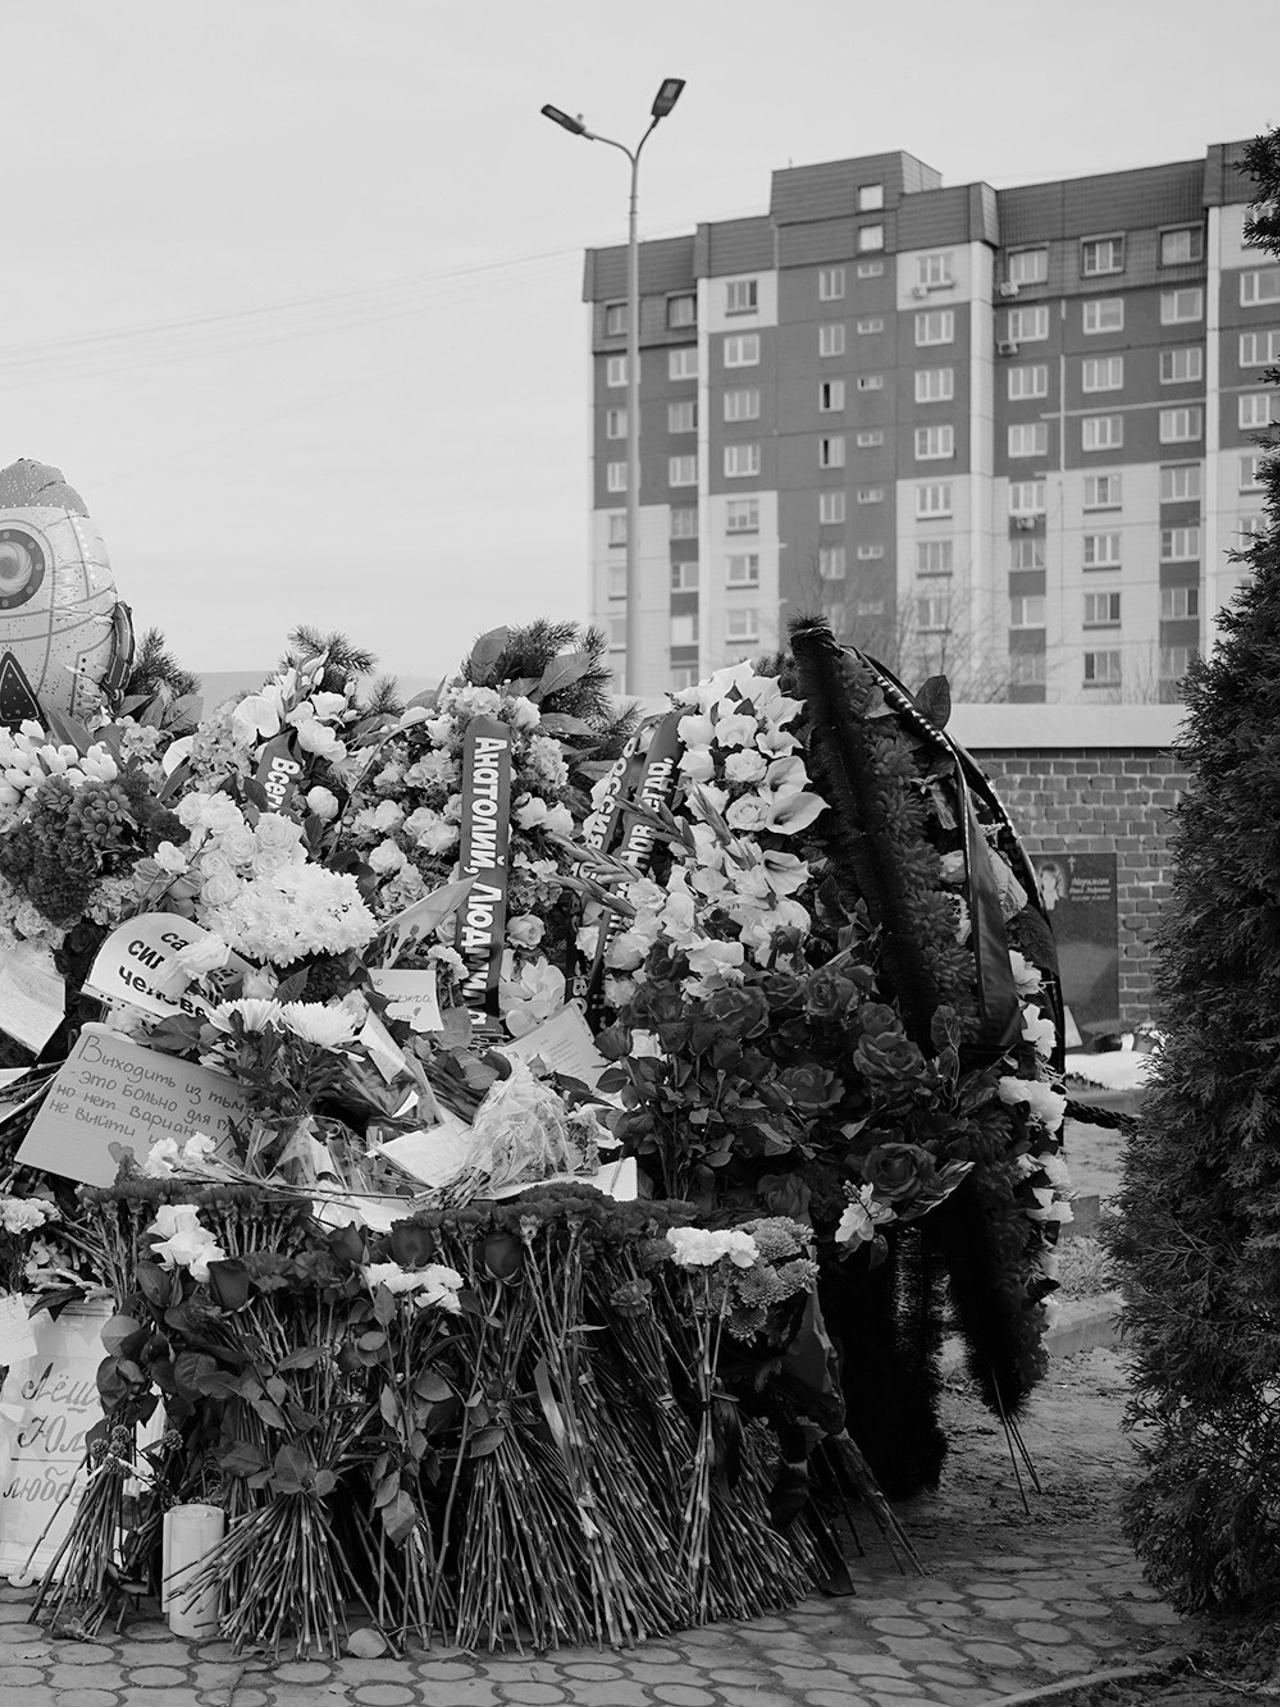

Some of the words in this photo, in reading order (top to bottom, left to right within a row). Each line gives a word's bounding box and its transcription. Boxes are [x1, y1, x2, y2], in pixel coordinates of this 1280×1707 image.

[78, 1035, 176, 1088] Выходить
[185, 1083, 202, 1105] из
[208, 1091, 245, 1113] тьм
[49, 1099, 70, 1114] не
[56, 1084, 76, 1098] но
[83, 1093, 116, 1111] нет
[183, 1109, 211, 1125] для
[21, 1362, 101, 1406] Лёш
[17, 1415, 87, 1454] Юл
